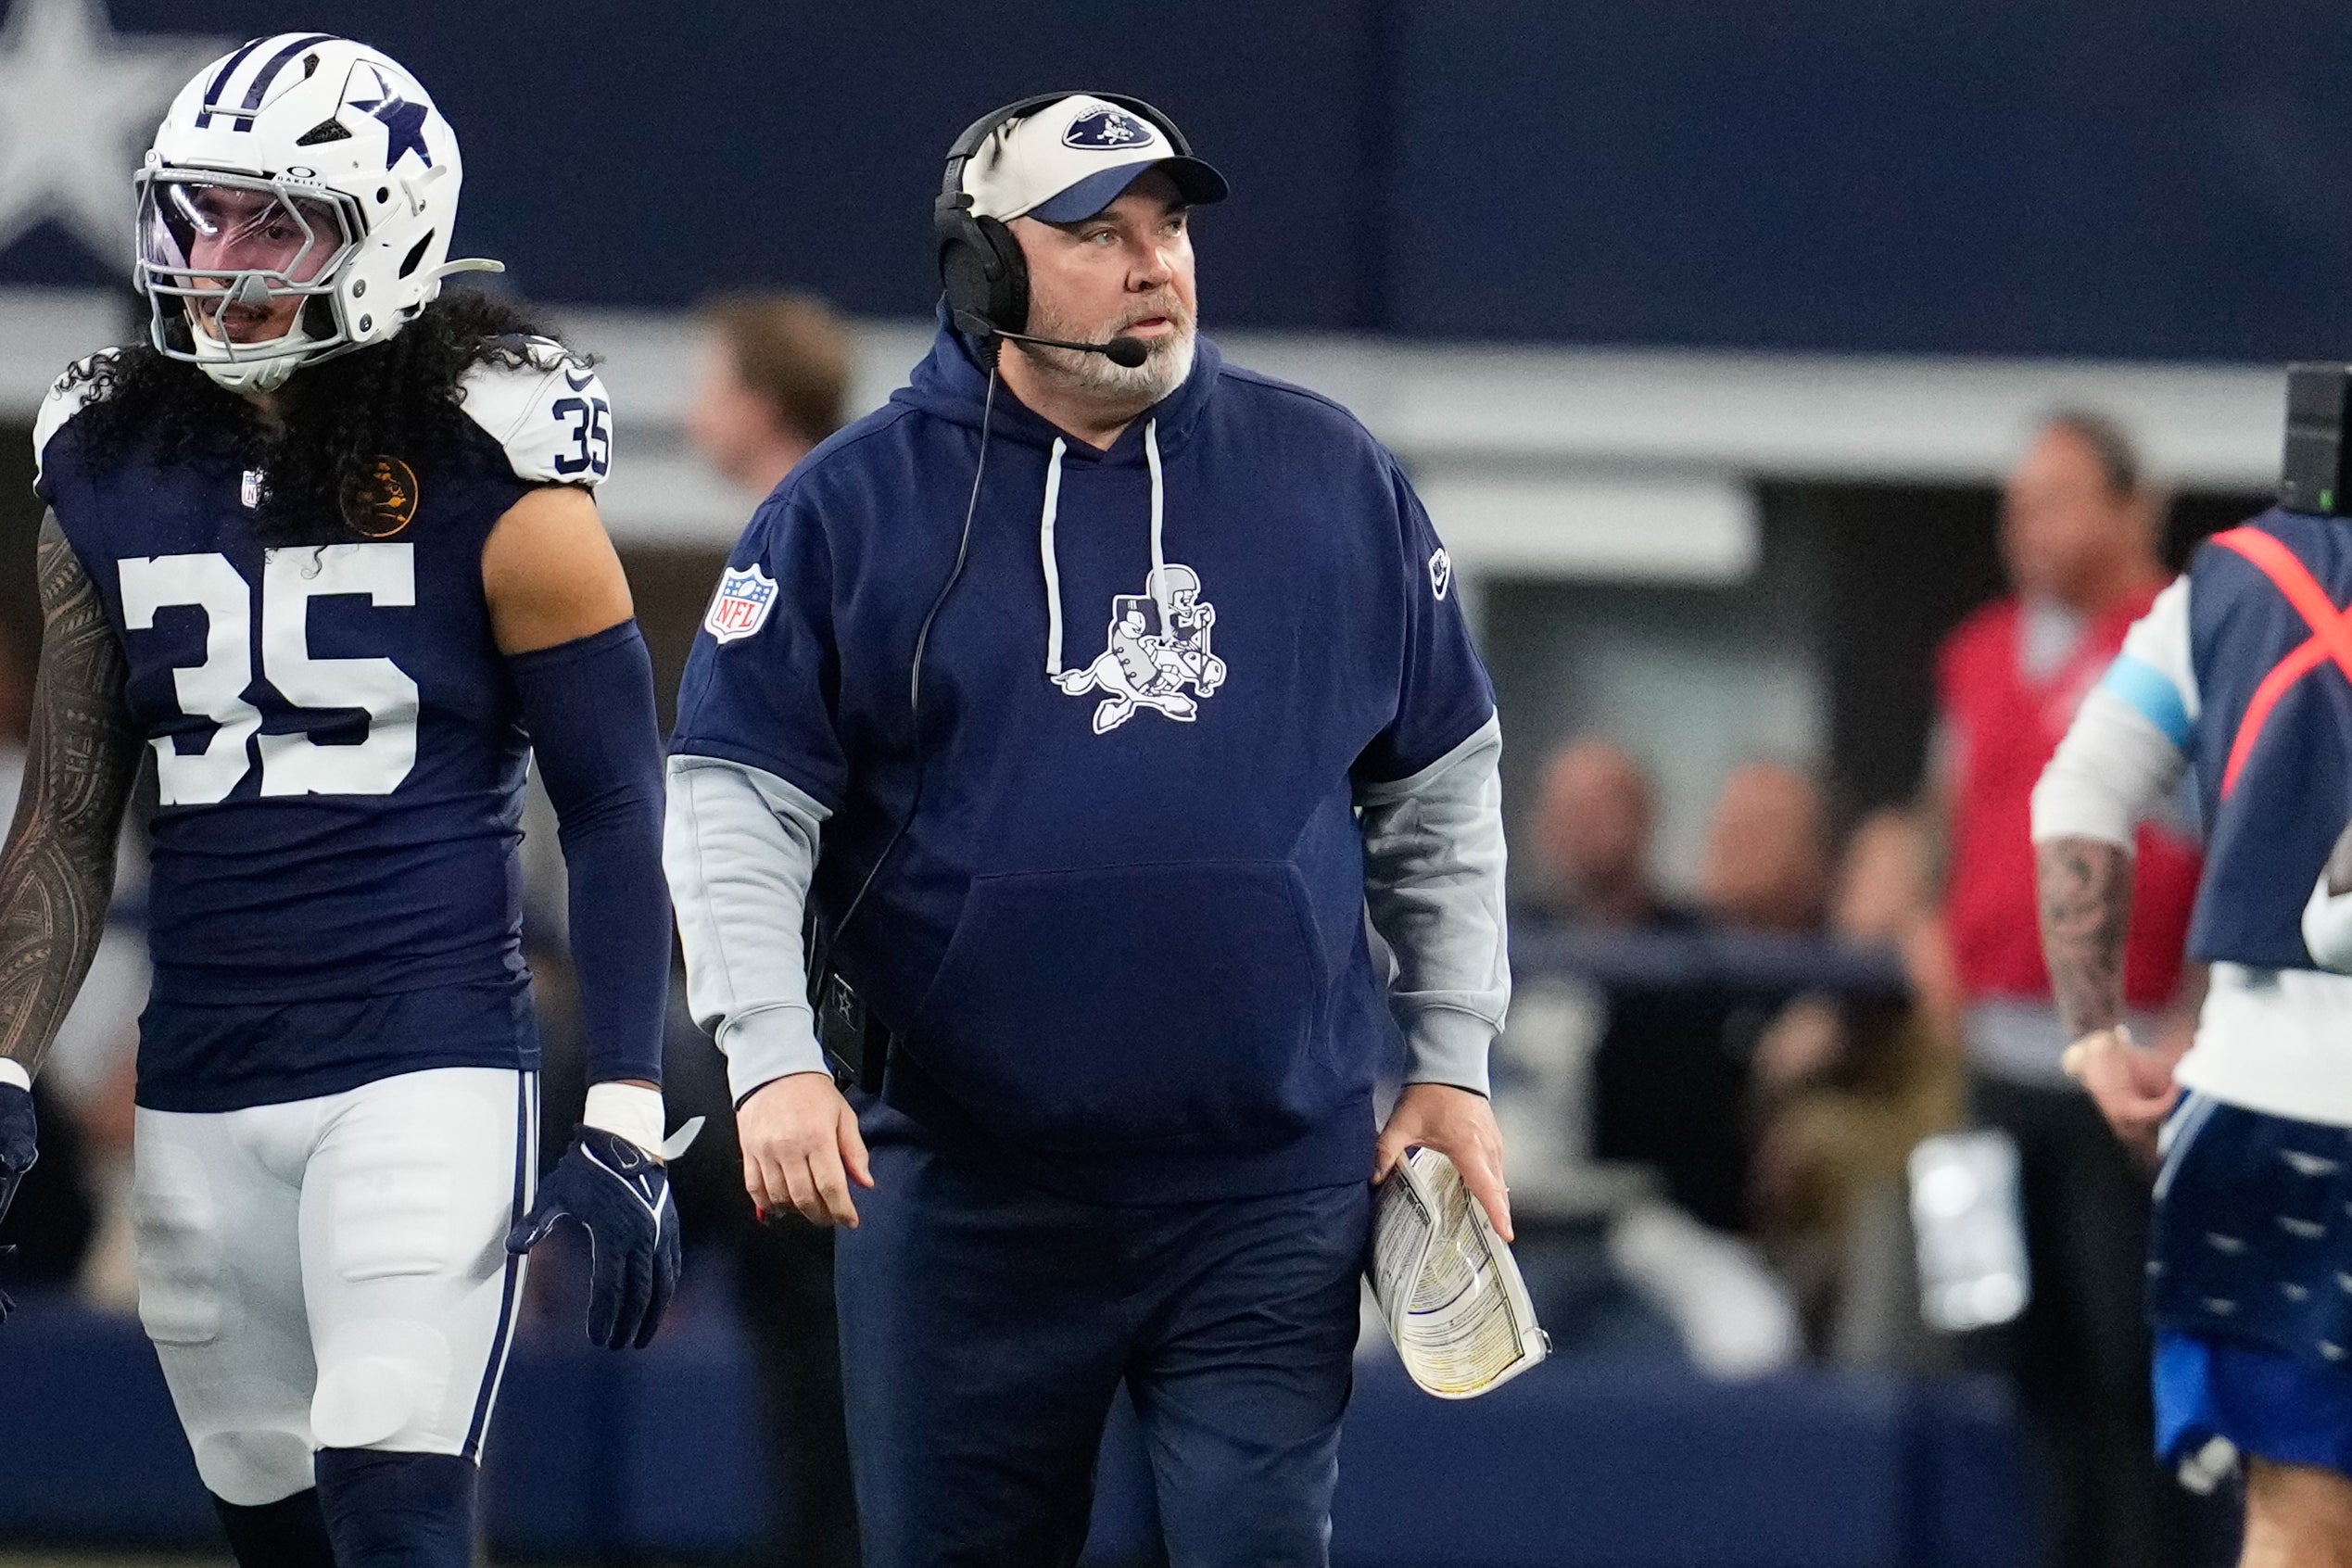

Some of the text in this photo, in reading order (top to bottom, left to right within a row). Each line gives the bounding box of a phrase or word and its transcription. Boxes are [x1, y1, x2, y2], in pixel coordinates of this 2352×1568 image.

[277, 175, 322, 186] OAKLEY
[551, 397, 611, 477] 35
[714, 598, 756, 629] NFL
[117, 542, 420, 806] 35
